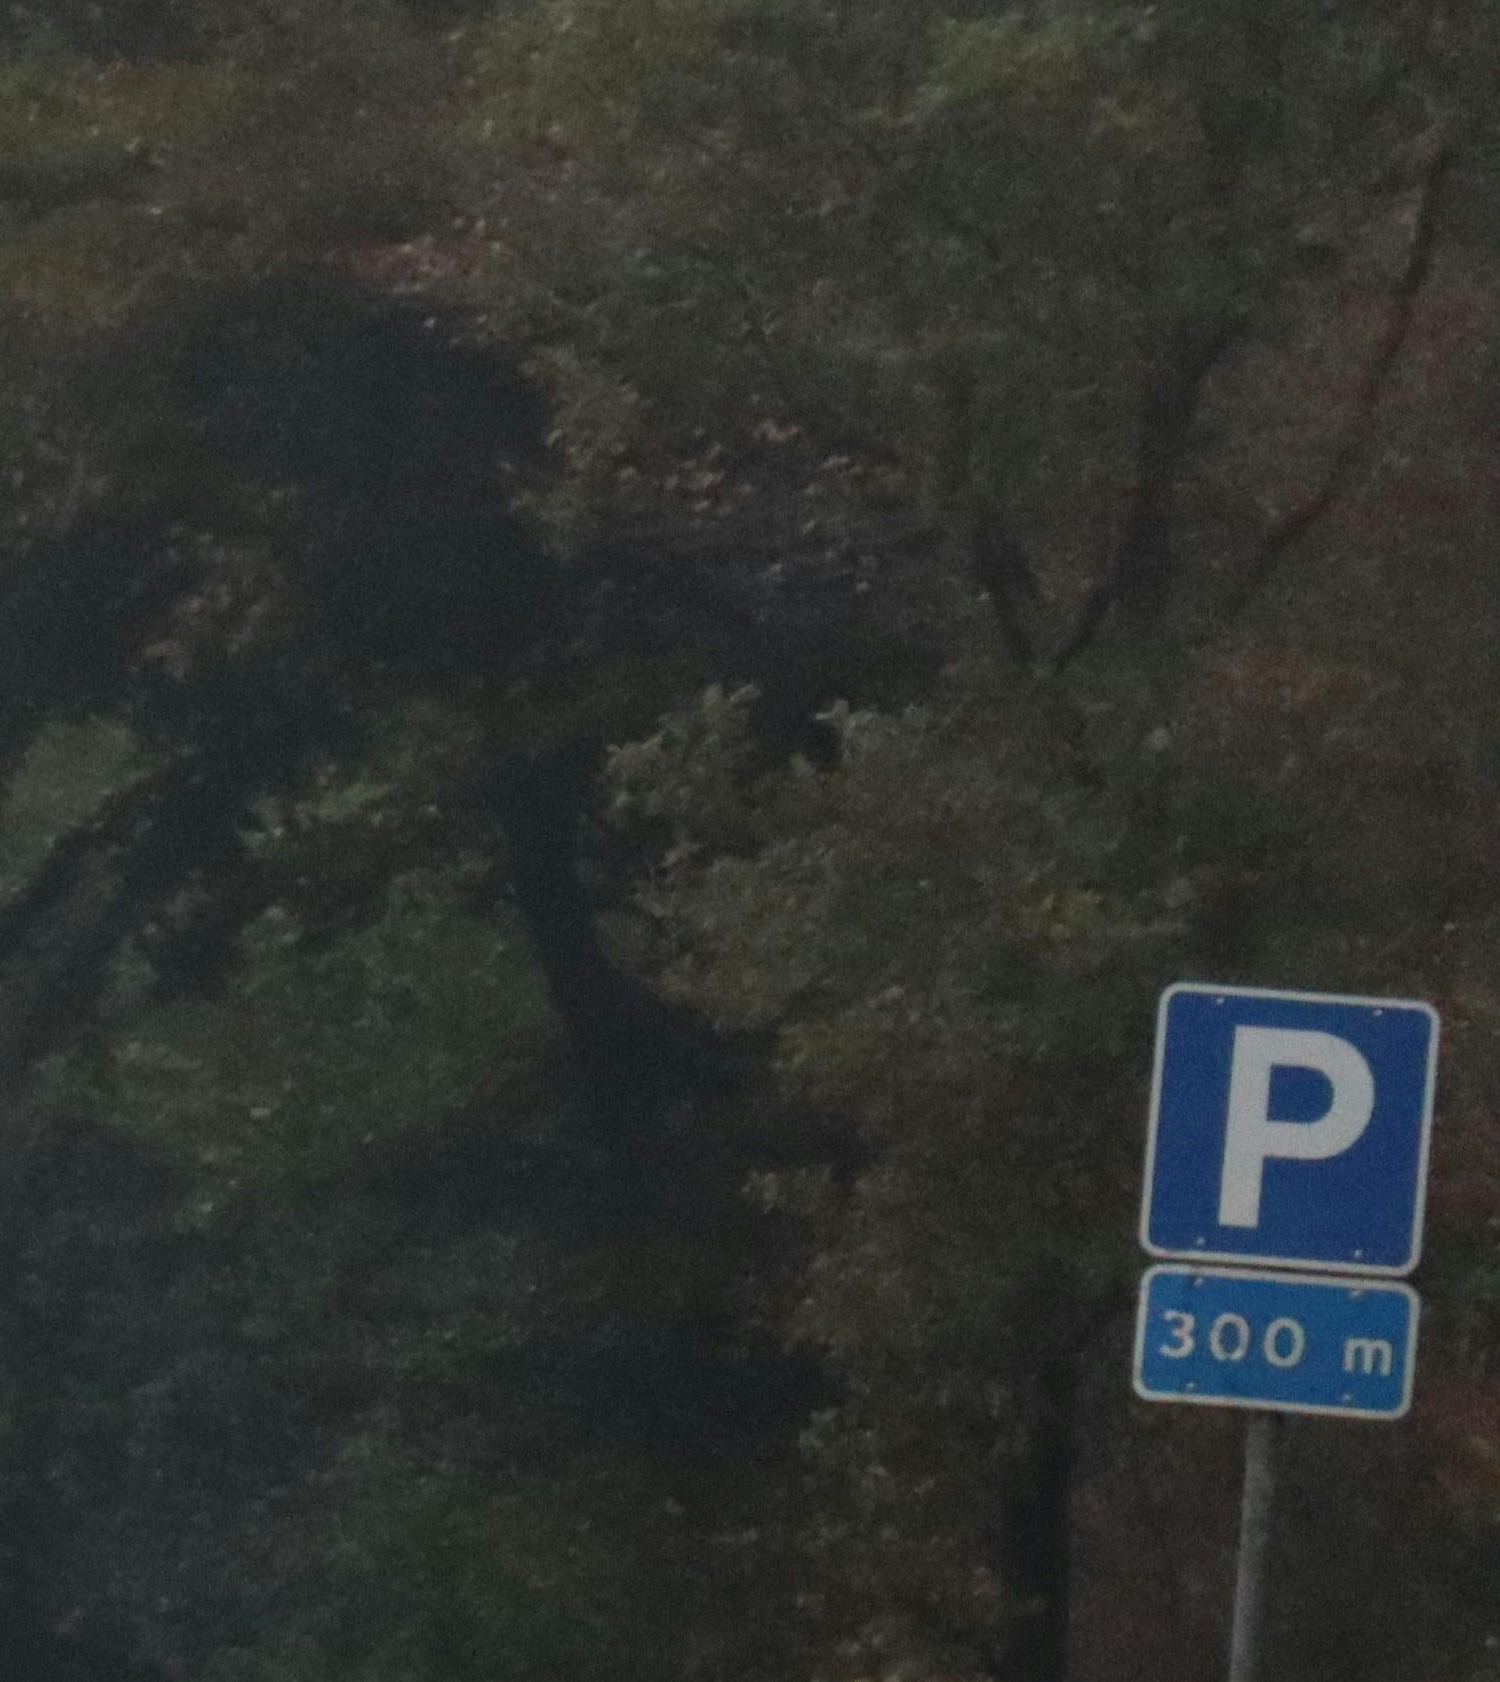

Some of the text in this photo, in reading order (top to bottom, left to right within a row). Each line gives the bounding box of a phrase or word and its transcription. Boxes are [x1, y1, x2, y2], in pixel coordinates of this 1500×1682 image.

[1219, 1024, 1375, 1229] P
[1159, 1309, 1392, 1376] 300 m
